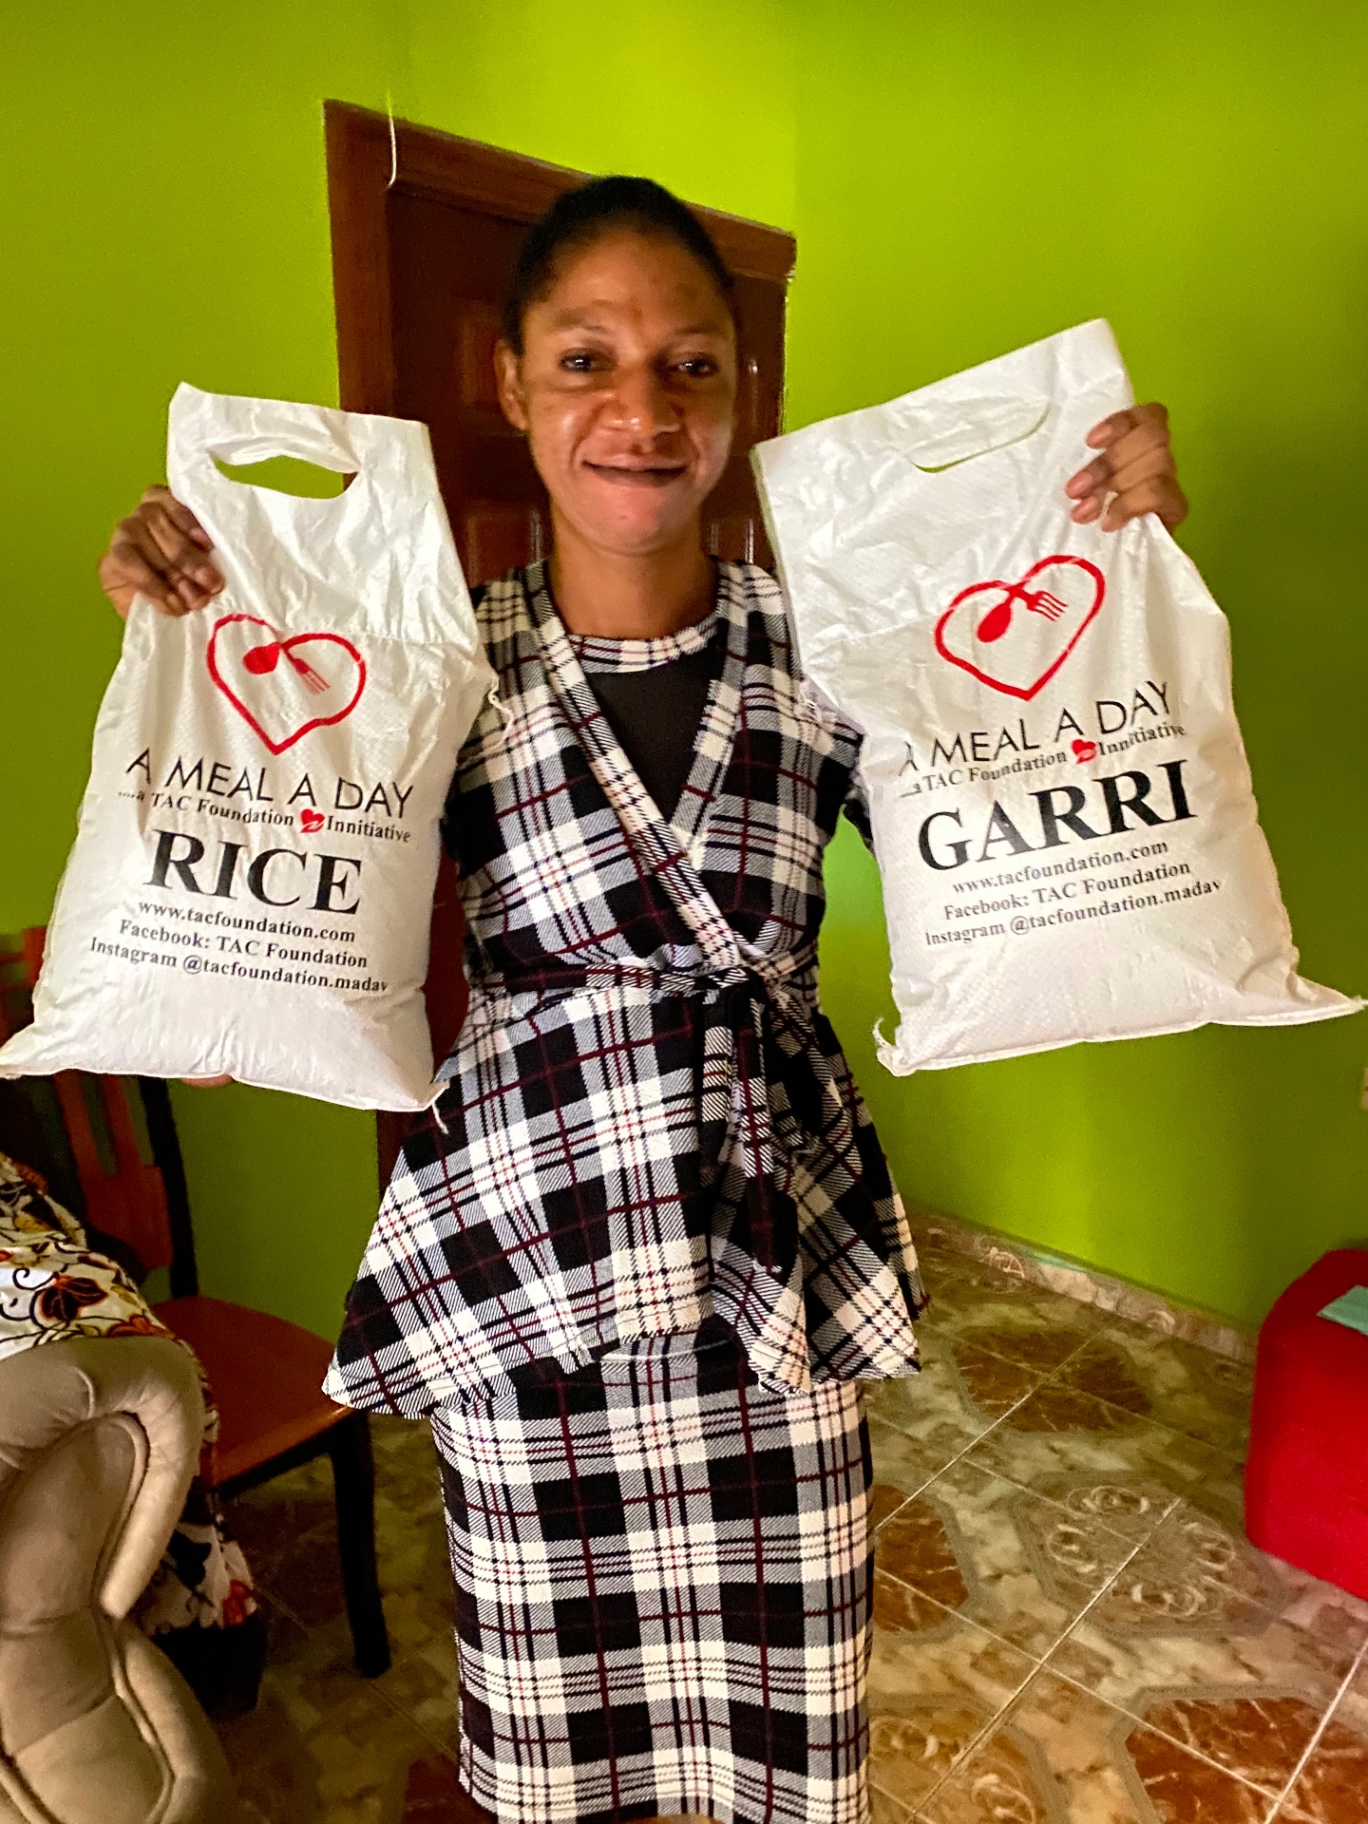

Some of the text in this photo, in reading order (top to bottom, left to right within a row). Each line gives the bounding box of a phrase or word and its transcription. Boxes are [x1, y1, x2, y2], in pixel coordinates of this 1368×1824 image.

[931, 718, 1040, 767] MEAL
[1054, 708, 1084, 743] A
[1096, 681, 1170, 735] DAY
[126, 748, 414, 819] A MEAL A DAY
[923, 770, 963, 791] TAC
[969, 751, 1067, 782] Foundation
[151, 792, 192, 810] TAC
[198, 799, 294, 826] Foundation
[327, 815, 411, 843] Innitiative
[918, 759, 1198, 871] GARRI
[143, 829, 362, 915] RICE
[944, 862, 1191, 920] Facebook: TAC Foundation
[953, 842, 1169, 894] www.tacfoundation.com
[119, 919, 367, 967] Facebook: TAC Foundation
[139, 901, 355, 942] www.tacfoundation.com
[926, 922, 1005, 946] Instagram
[90, 937, 177, 967] Instagram
